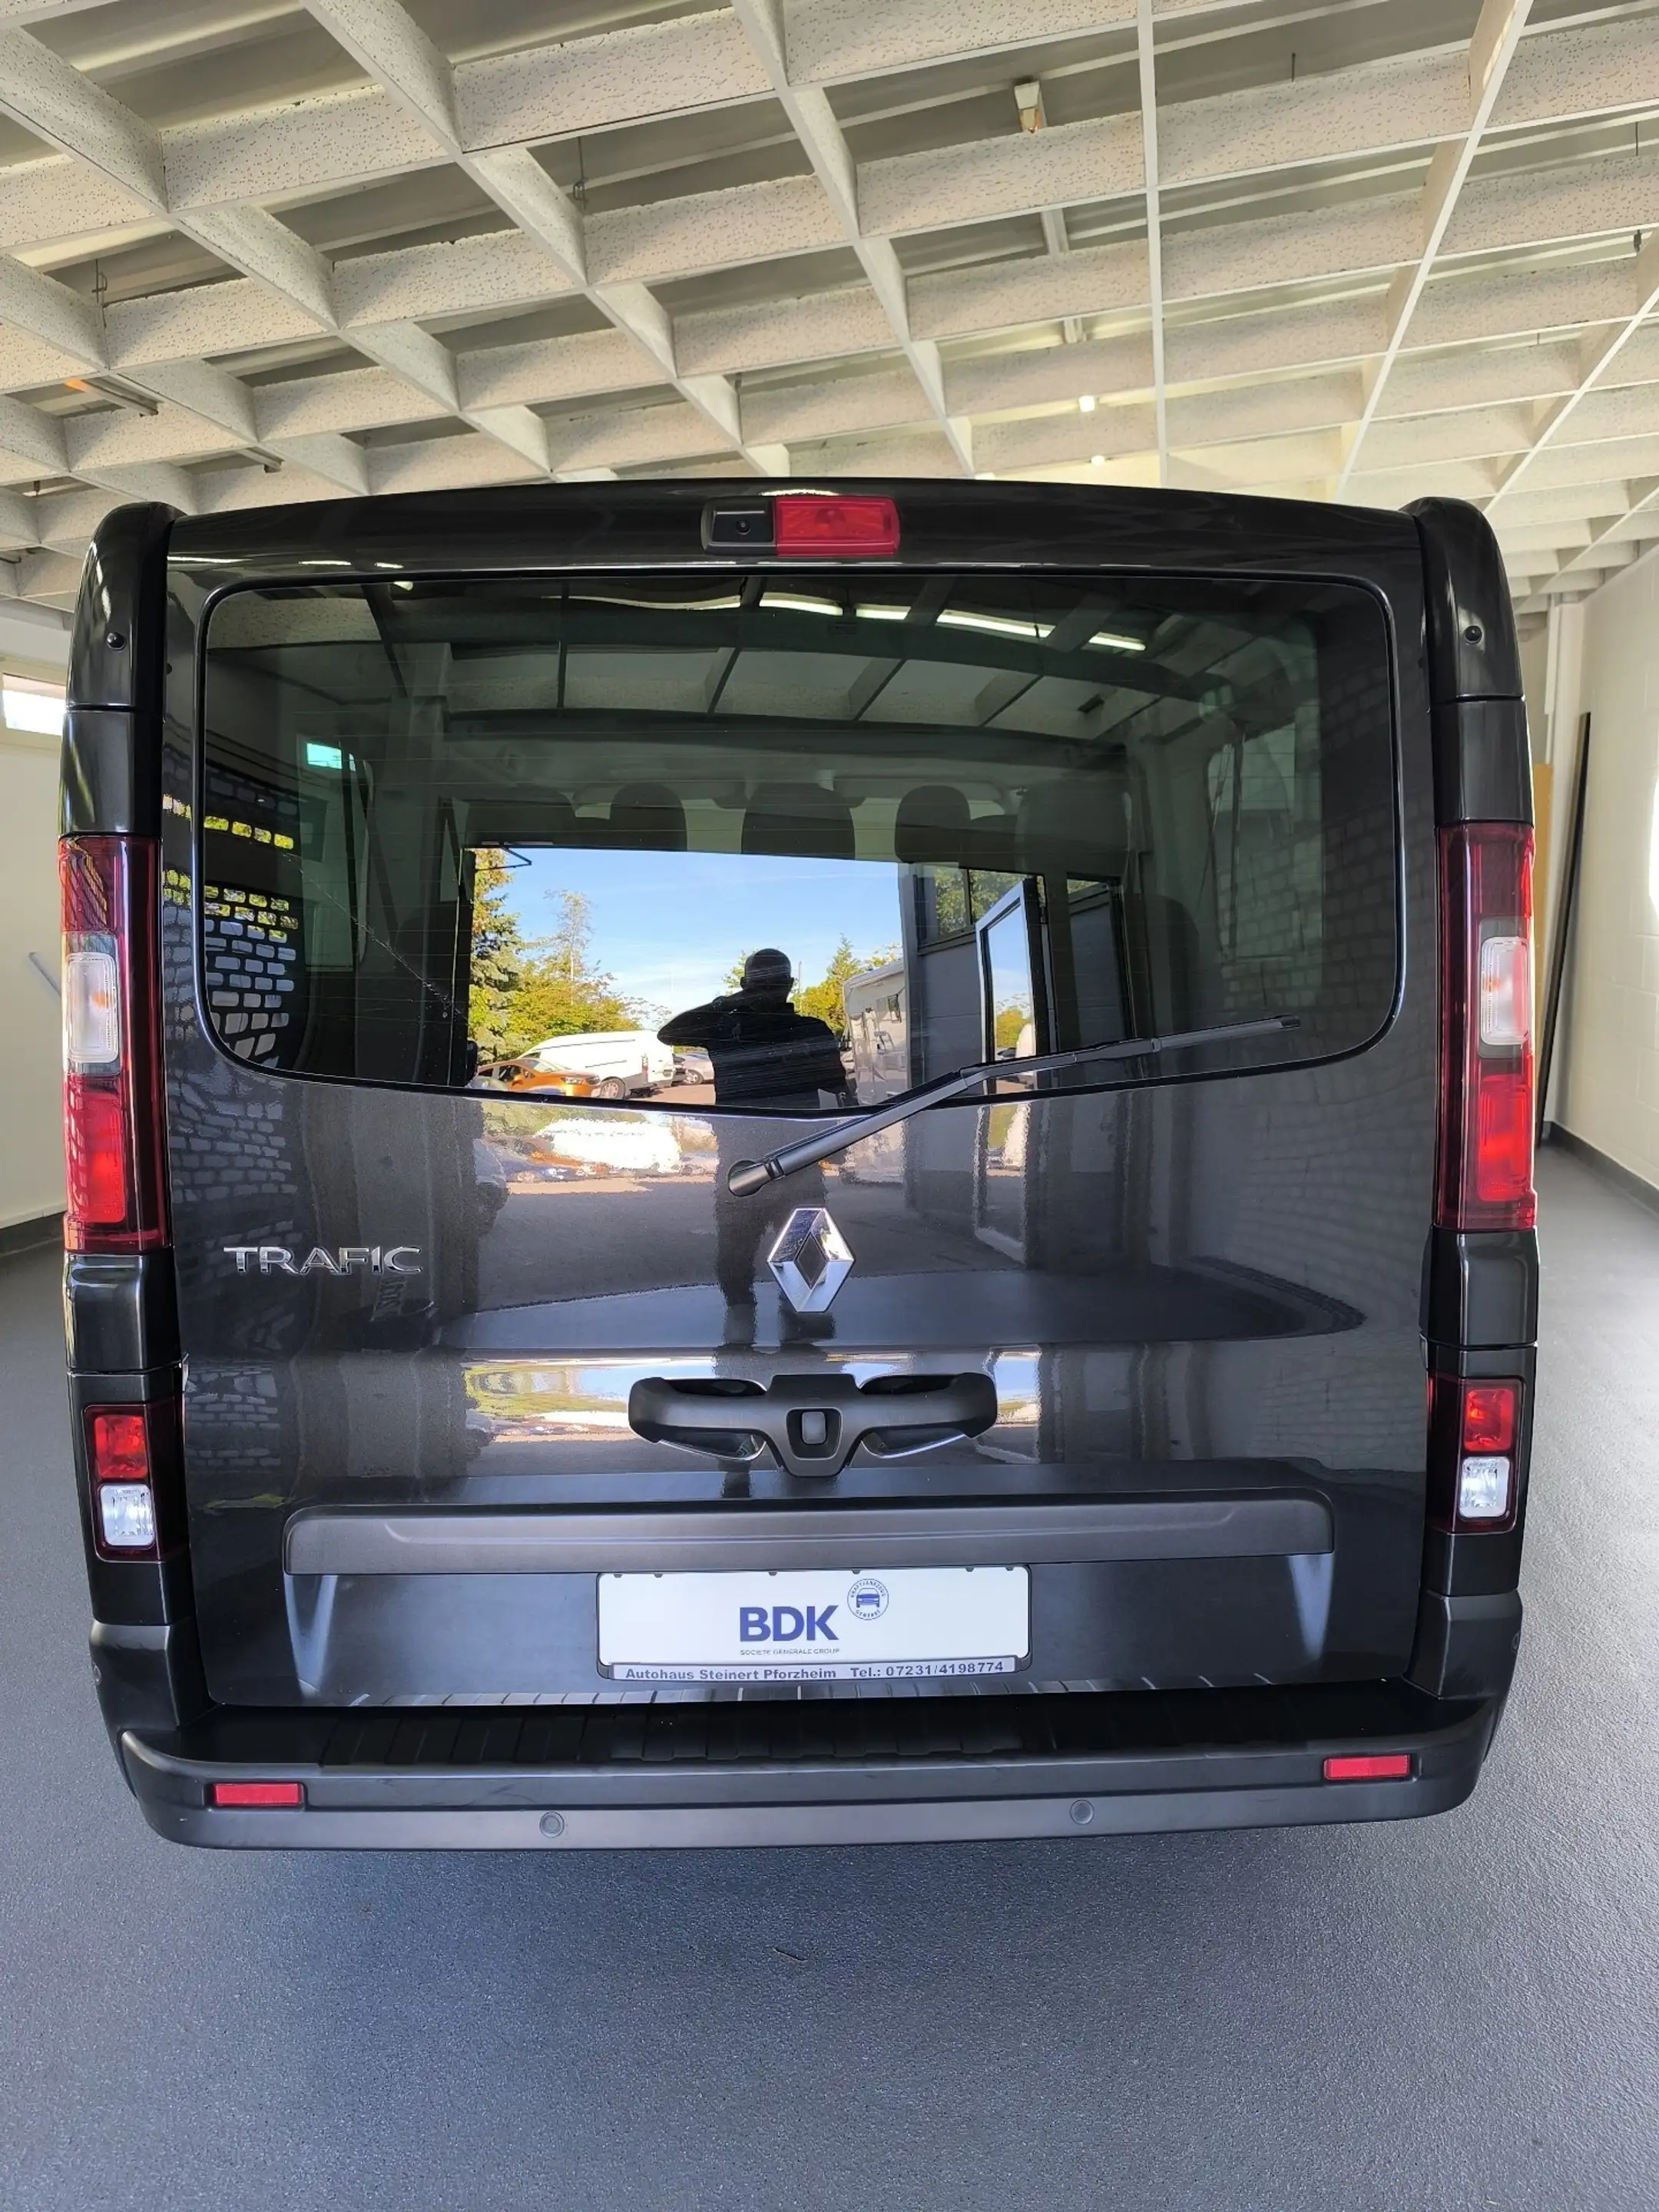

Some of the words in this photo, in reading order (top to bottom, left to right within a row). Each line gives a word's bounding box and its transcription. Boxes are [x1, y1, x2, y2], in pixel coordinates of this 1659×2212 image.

[224, 1246, 422, 1274] TRAFIC
[740, 1605, 839, 1641] BDK
[626, 1668, 694, 1680] Autohaus
[700, 1668, 758, 1680] Steinert
[763, 1667, 836, 1680] Pforzheim
[850, 1667, 881, 1677] Tel.:
[886, 1661, 1004, 1676] 07231/4198774
